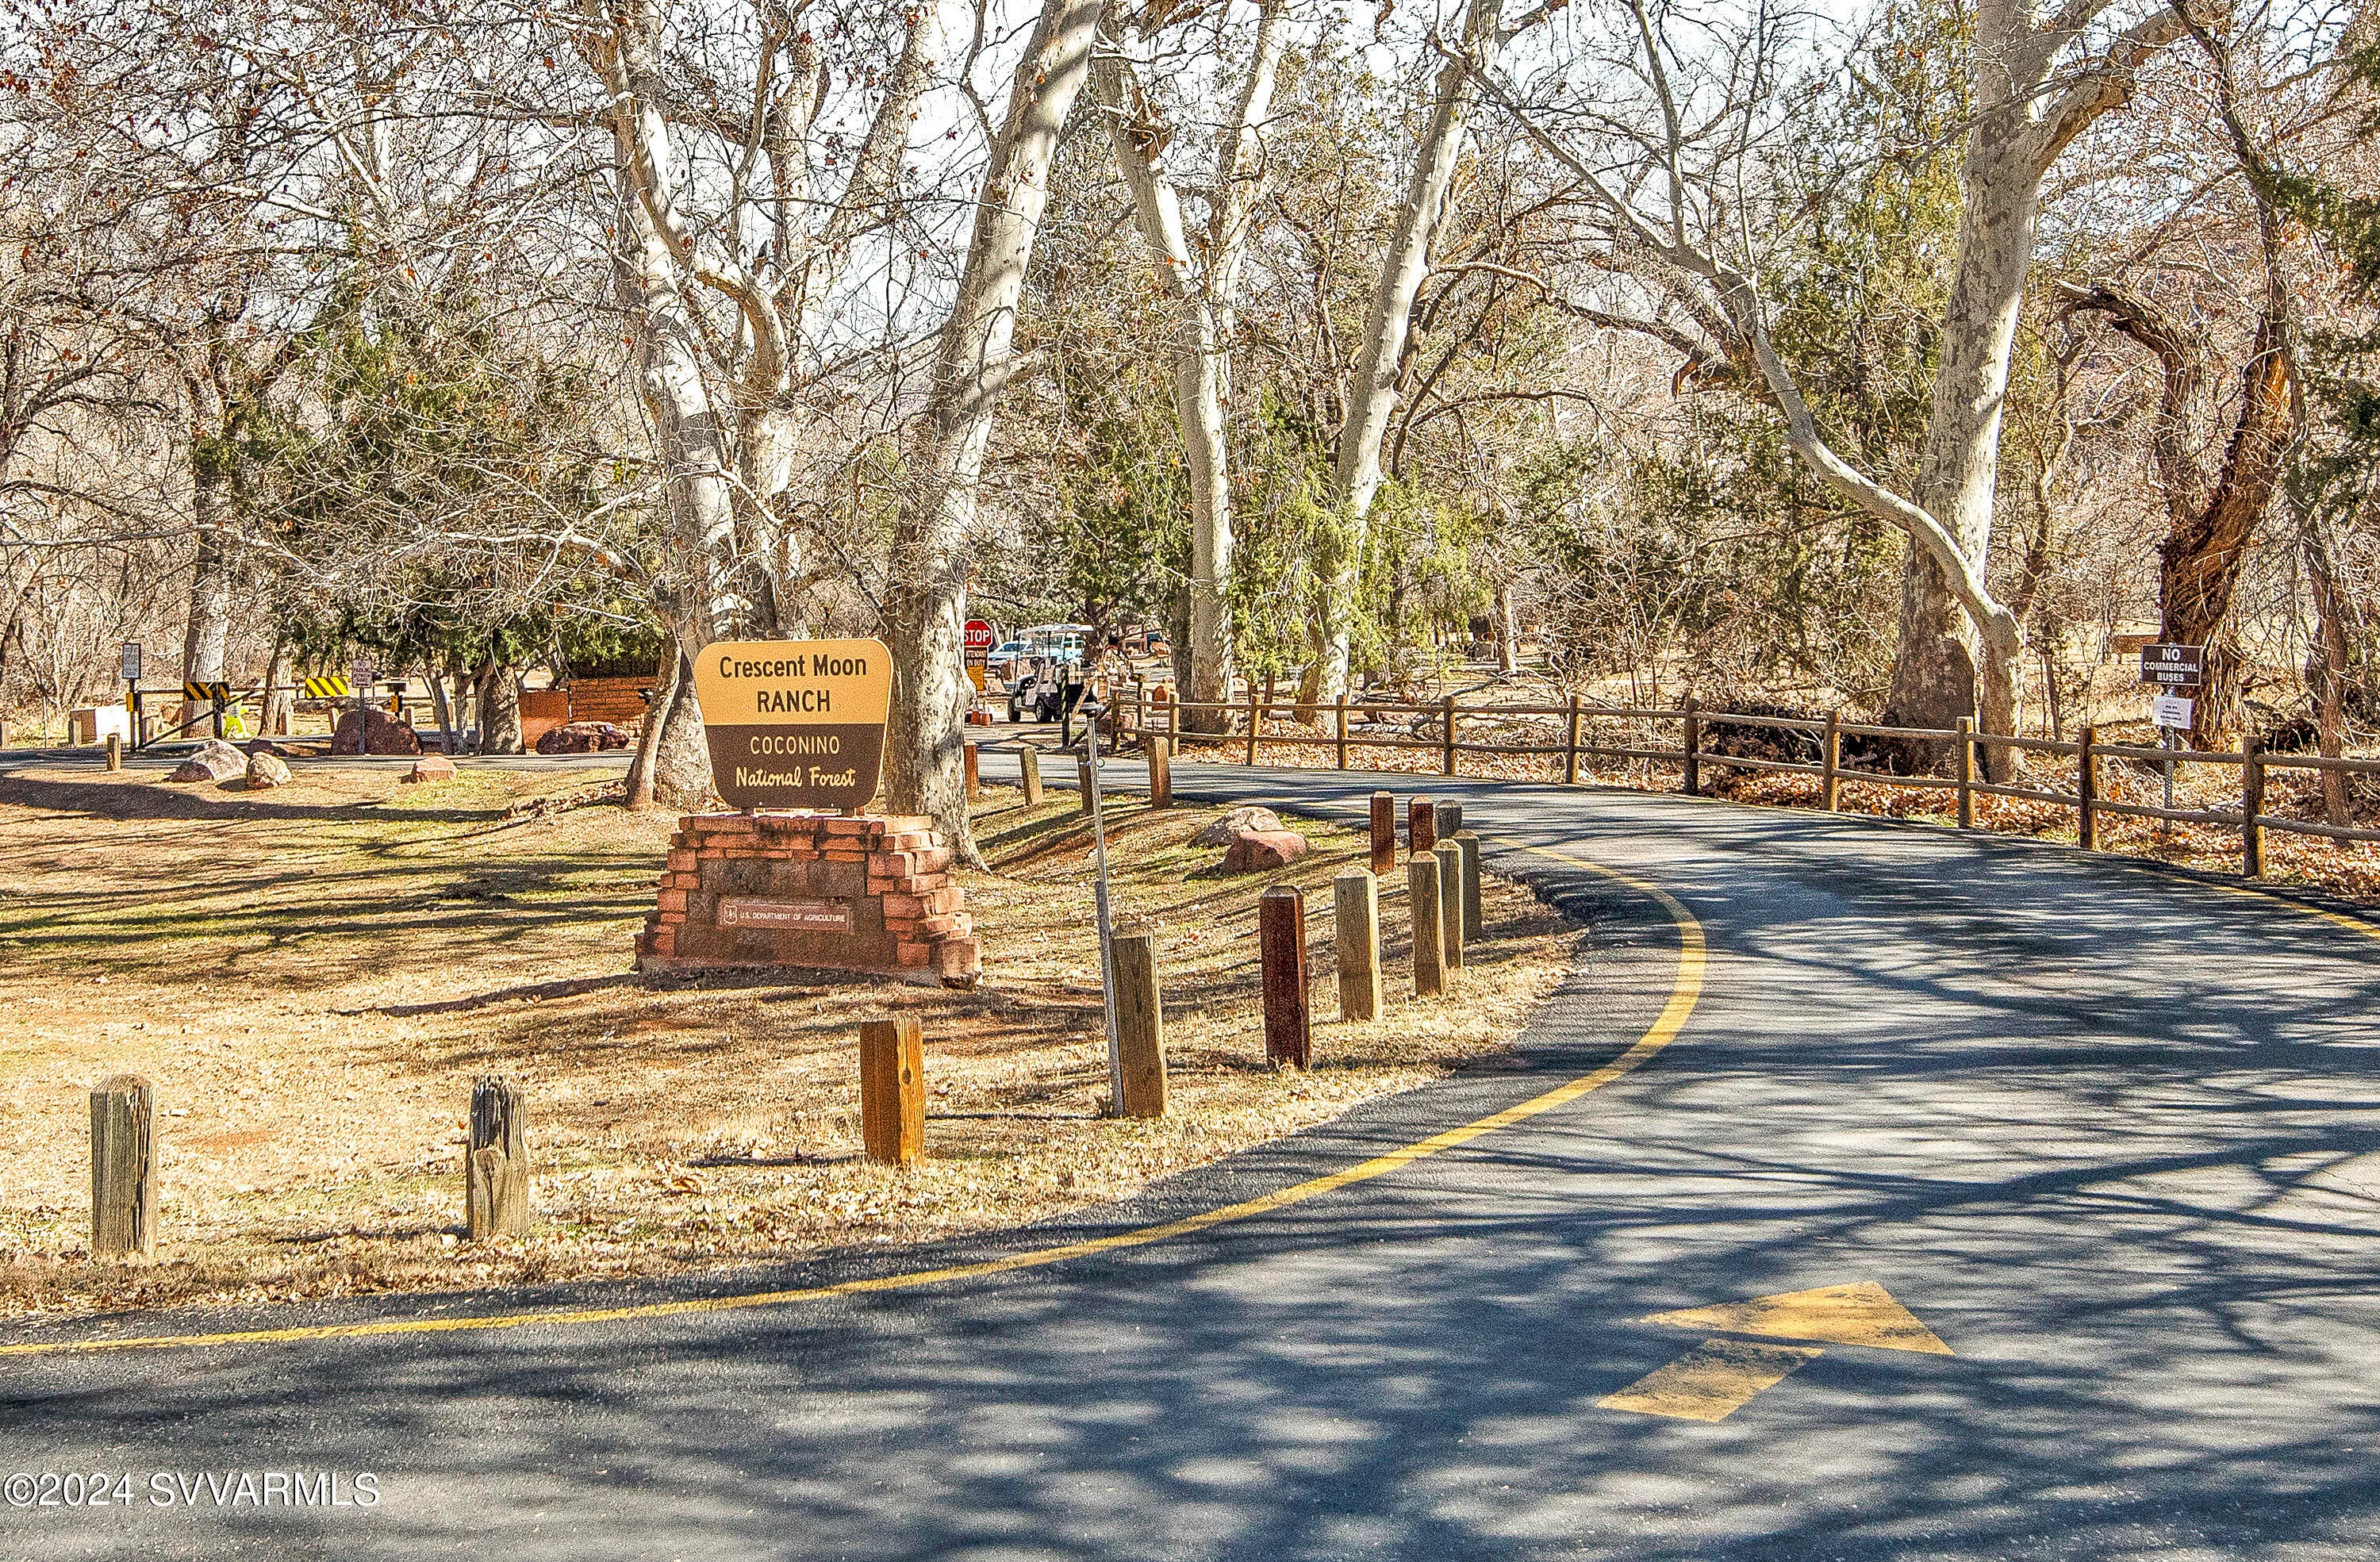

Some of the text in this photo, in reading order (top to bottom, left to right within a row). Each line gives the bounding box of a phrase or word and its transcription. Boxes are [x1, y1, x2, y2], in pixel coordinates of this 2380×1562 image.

[964, 629, 990, 643] STOP
[2162, 648, 2180, 661] NO
[720, 654, 866, 678] Crescent Moon
[2144, 662, 2198, 673] COMMERCIAL
[2156, 673, 2184, 682] BUSES
[757, 689, 830, 712] RANCH
[750, 735, 839, 754] COCONINO
[735, 766, 856, 787] National Forest
[752, 912, 791, 921] DEPARTMENT
[804, 914, 846, 923] AGRICULTURE
